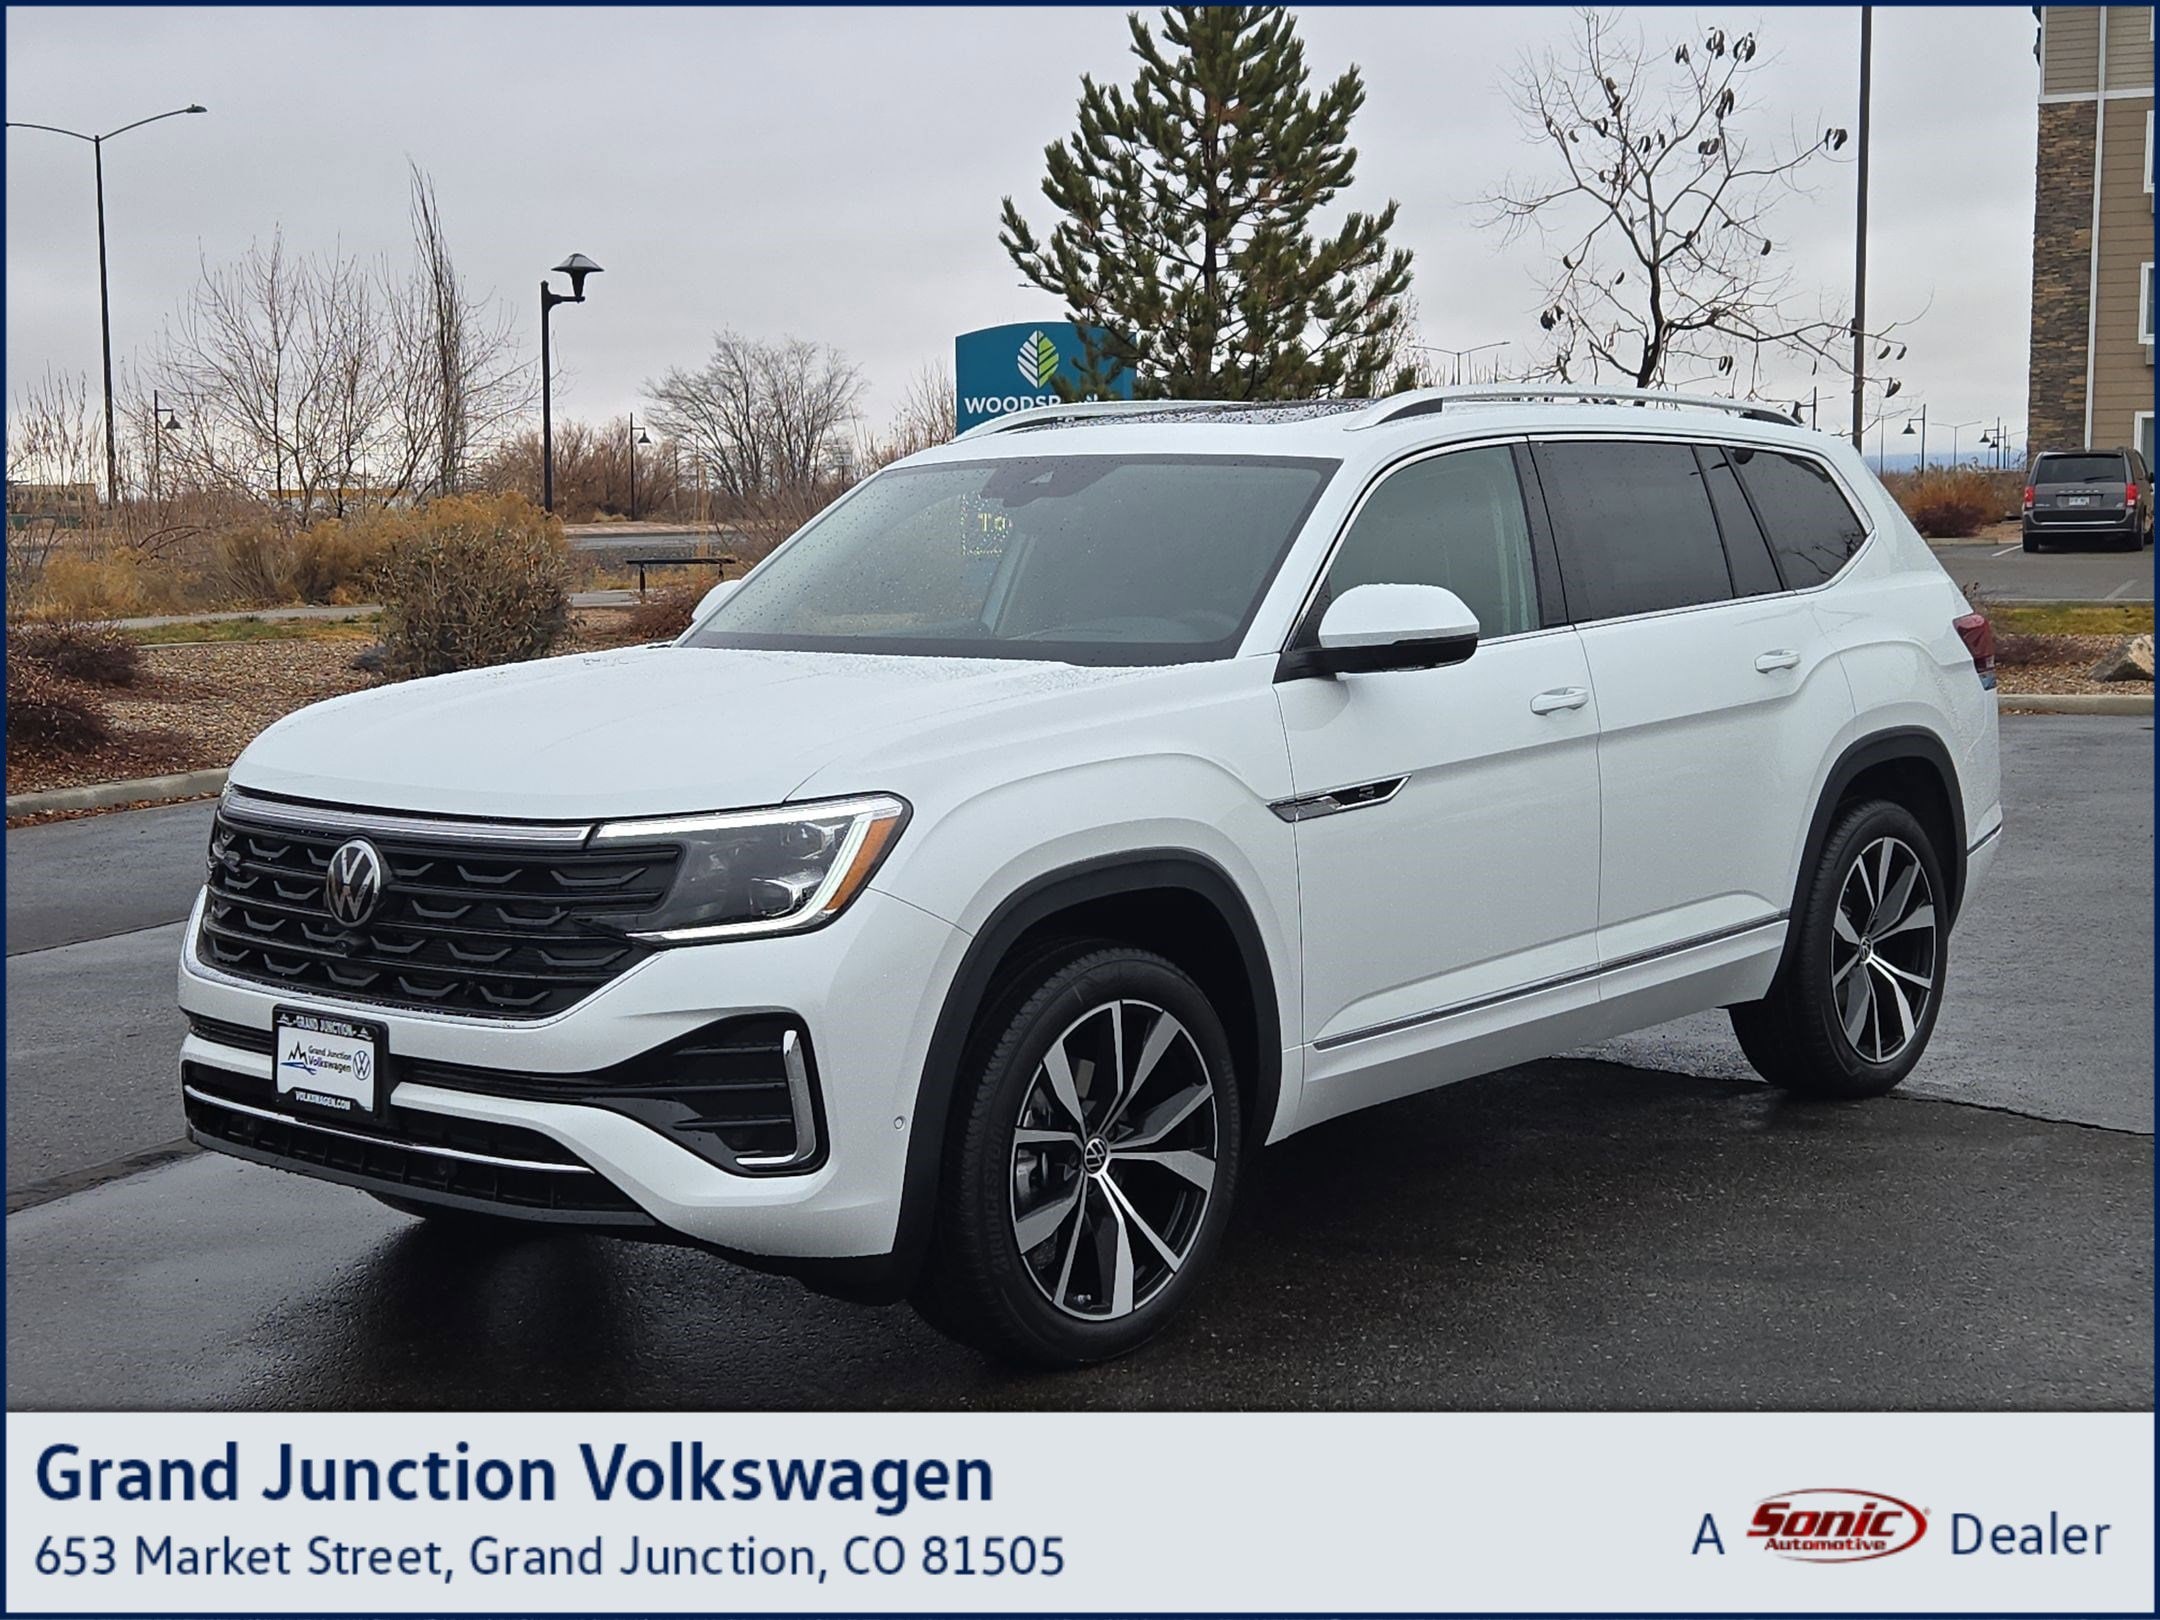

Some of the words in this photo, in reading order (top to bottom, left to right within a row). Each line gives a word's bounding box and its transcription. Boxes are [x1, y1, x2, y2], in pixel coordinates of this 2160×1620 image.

[964, 393, 1099, 414] WOODSP
[296, 1015, 319, 1031] GRAND
[319, 1019, 353, 1037] JUNCTION
[307, 1044, 327, 1057] Grand
[327, 1049, 352, 1061] Junction
[307, 1055, 352, 1074] Volkswagen
[295, 1090, 351, 1111] VOLKSWAGEN.COM
